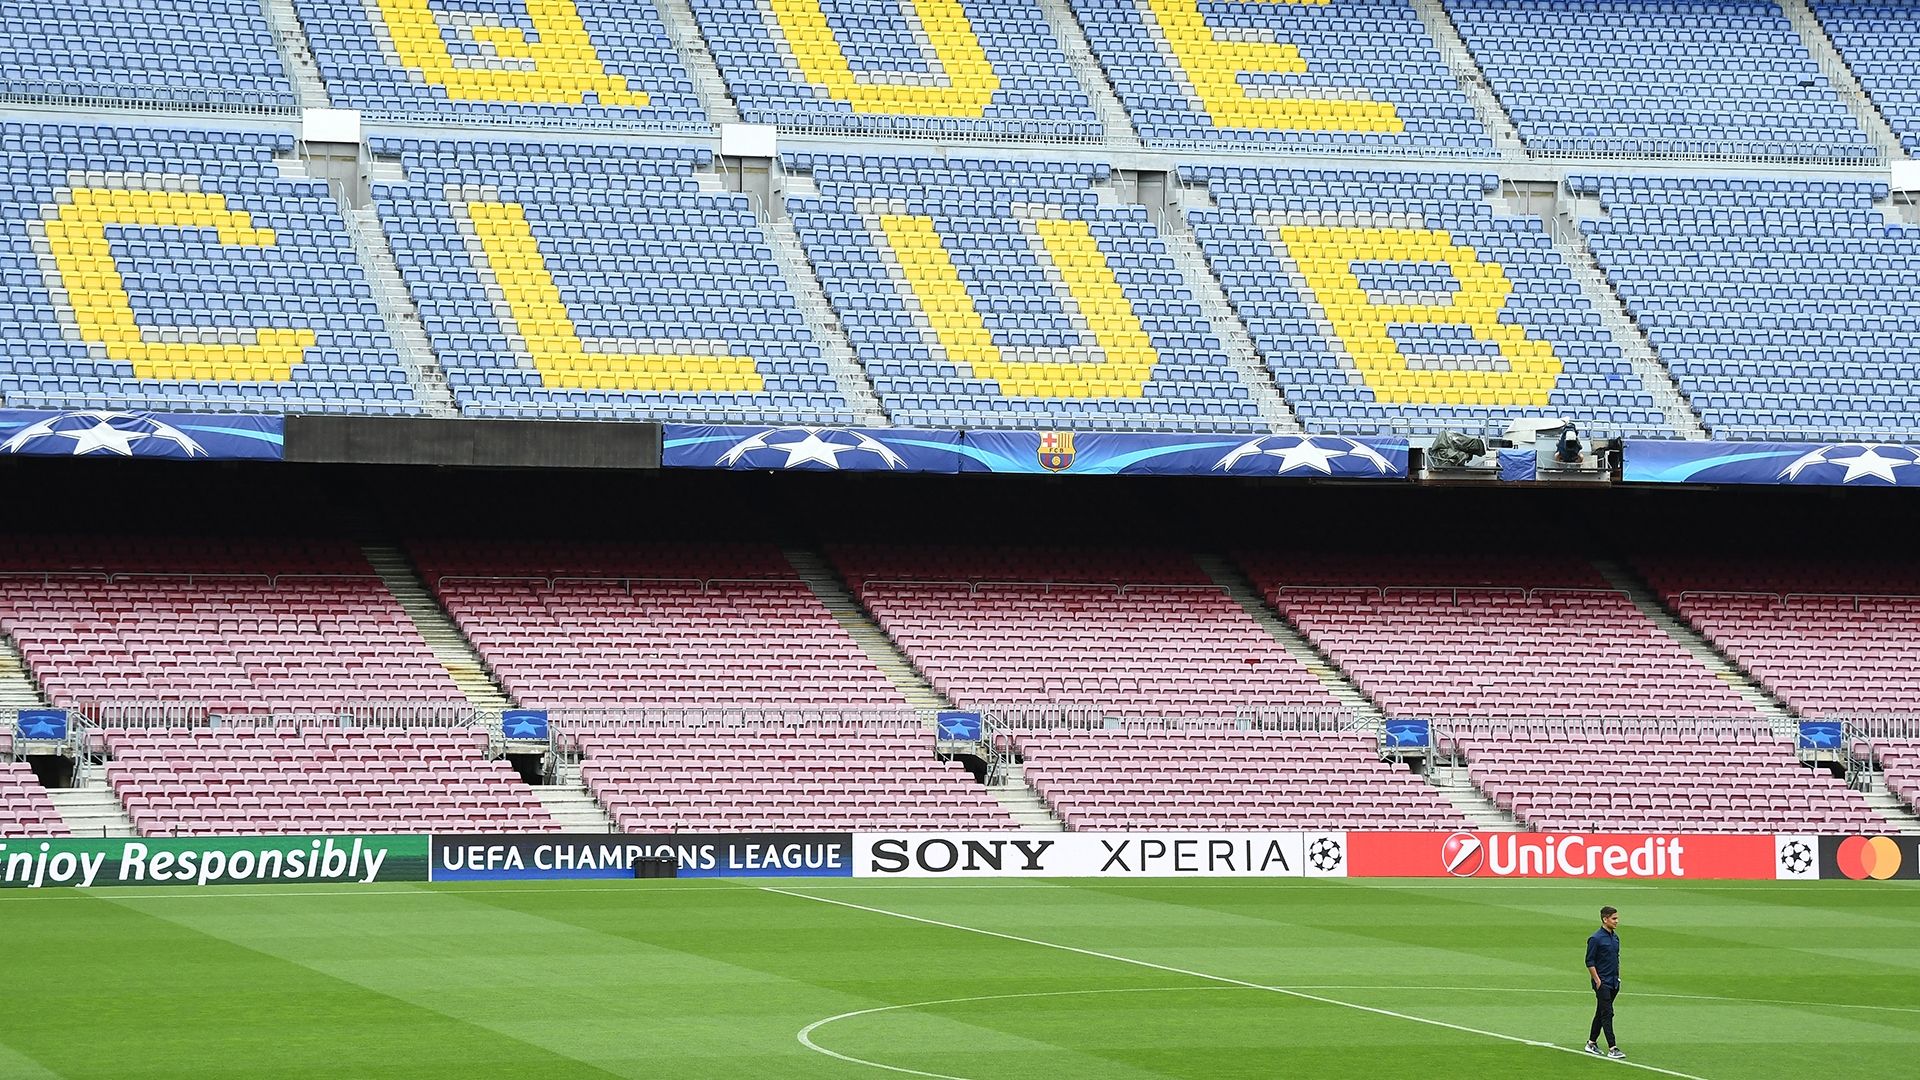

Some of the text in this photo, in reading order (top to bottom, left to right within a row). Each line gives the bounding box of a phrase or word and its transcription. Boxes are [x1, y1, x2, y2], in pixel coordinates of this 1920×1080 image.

[46, 189, 1563, 406] CLUB
[119, 838, 389, 885] Responsibly
[444, 846, 526, 872] UEFA
[730, 844, 843, 870] LEAGUE
[872, 840, 1291, 873] SONY XPERIA
[1489, 835, 1685, 875] UniCredit
